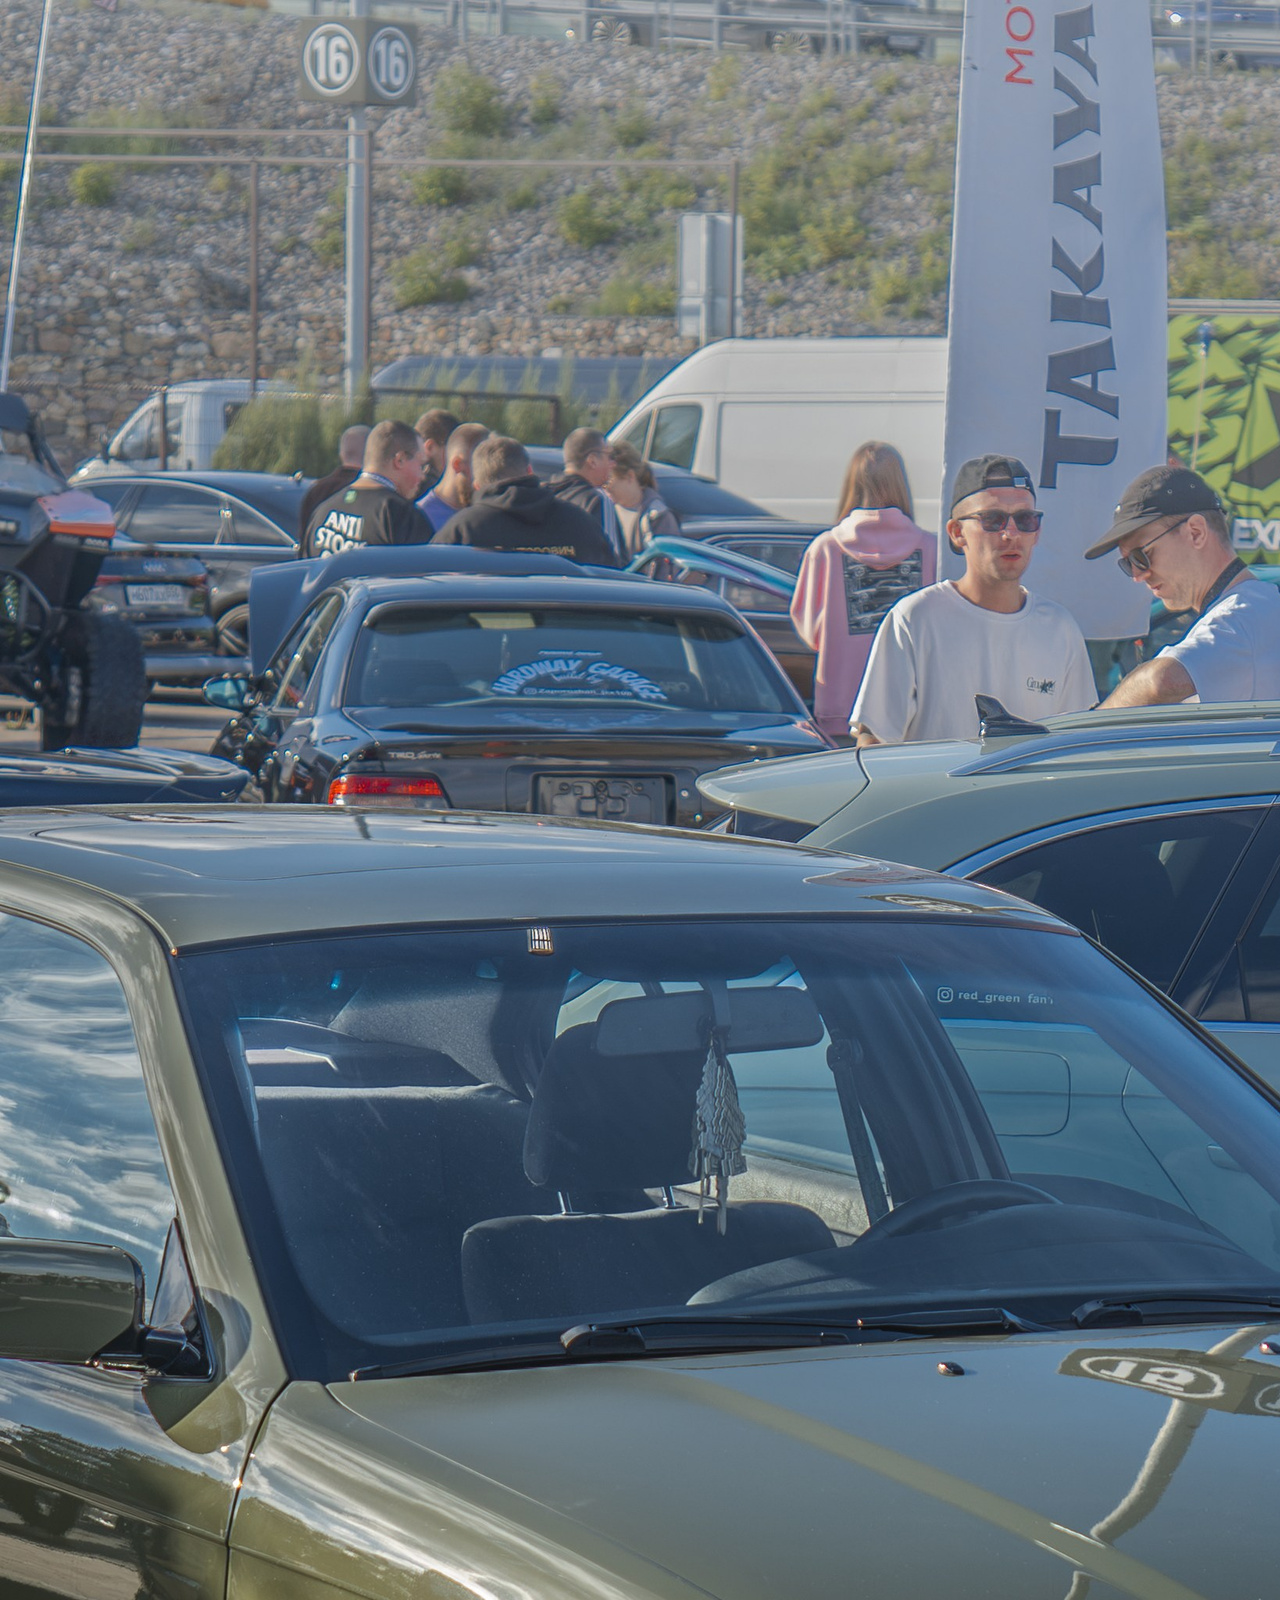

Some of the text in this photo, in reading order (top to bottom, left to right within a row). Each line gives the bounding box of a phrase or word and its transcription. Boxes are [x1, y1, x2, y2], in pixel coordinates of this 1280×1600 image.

[312, 35, 350, 83] 16
[376, 38, 406, 86] 16
[1005, 0, 1035, 85] MO
[326, 510, 364, 539] ANTI
[492, 658, 668, 699] HARDWAY GARAGE
